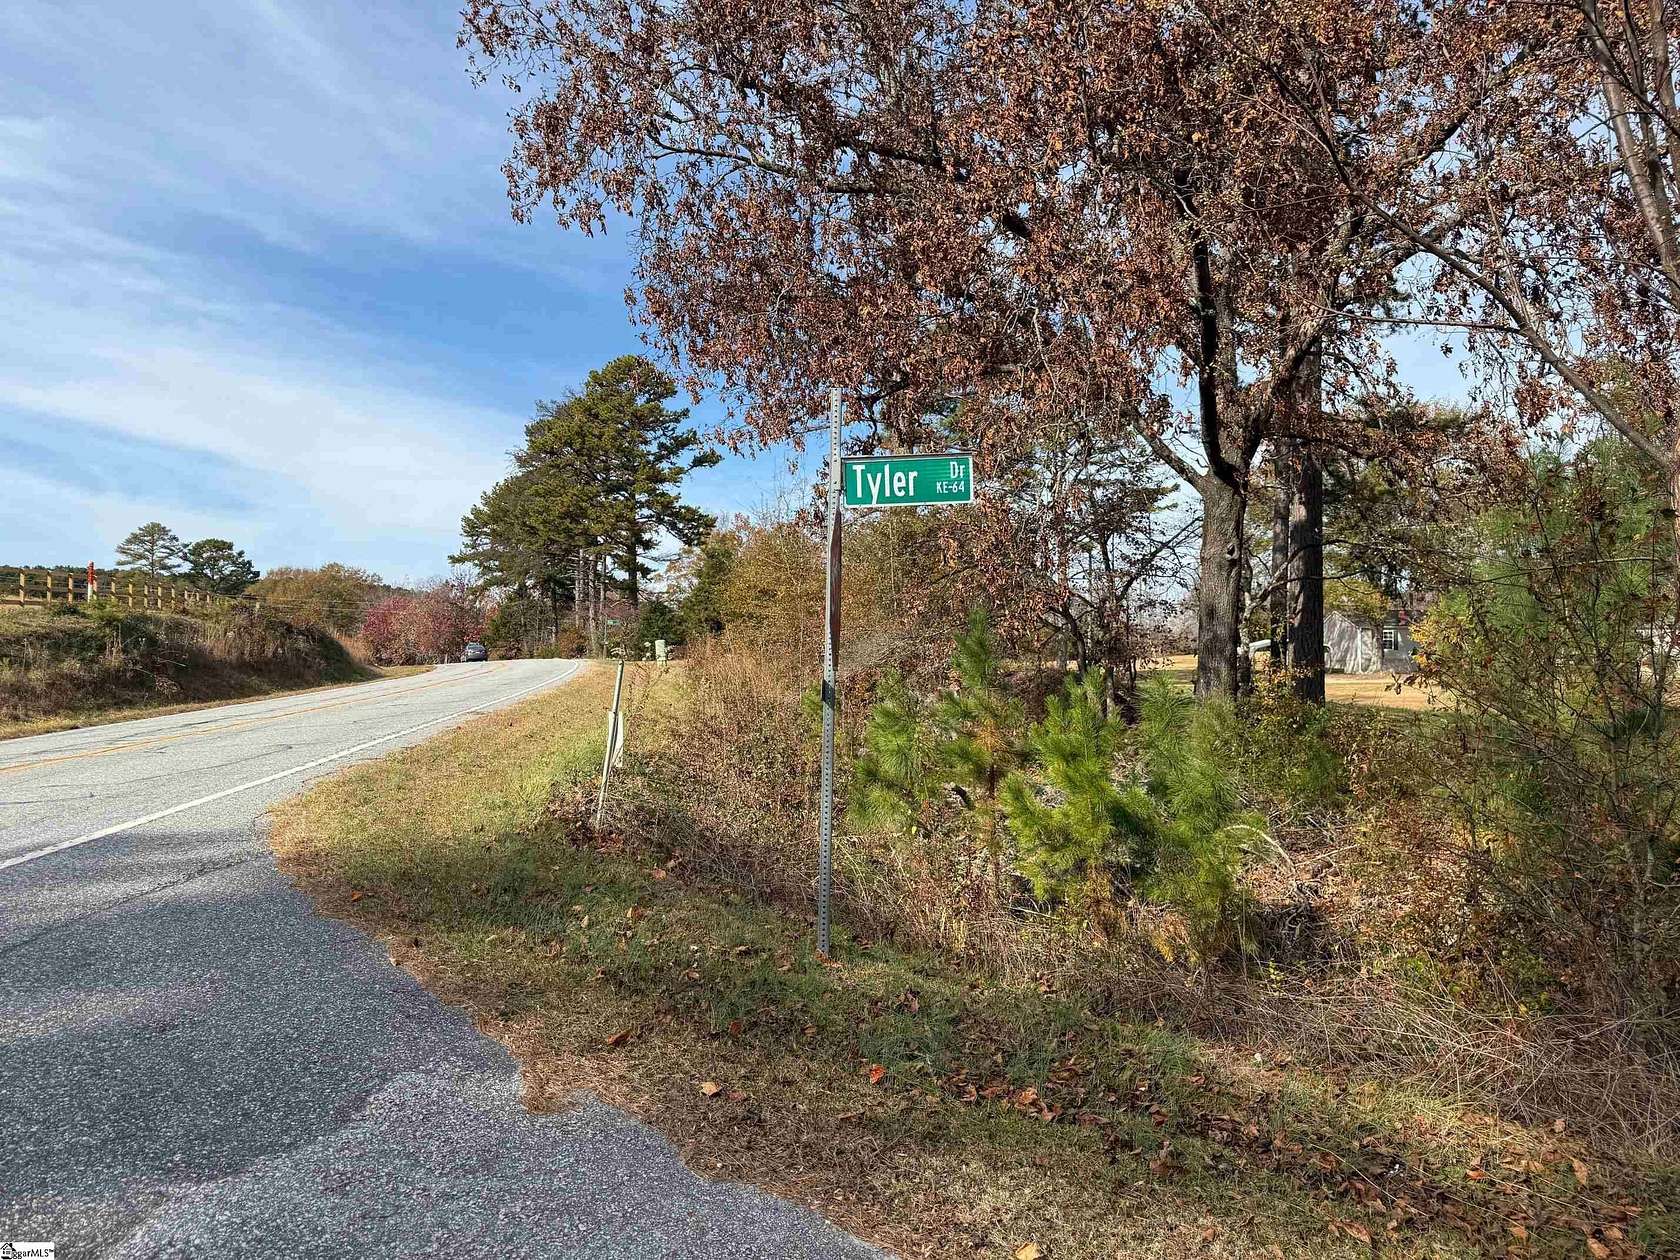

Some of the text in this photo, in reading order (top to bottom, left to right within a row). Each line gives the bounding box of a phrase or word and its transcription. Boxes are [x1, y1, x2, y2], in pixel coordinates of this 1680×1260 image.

[852, 461, 965, 504] Tyler Dr
[936, 480, 965, 494] KE-64
